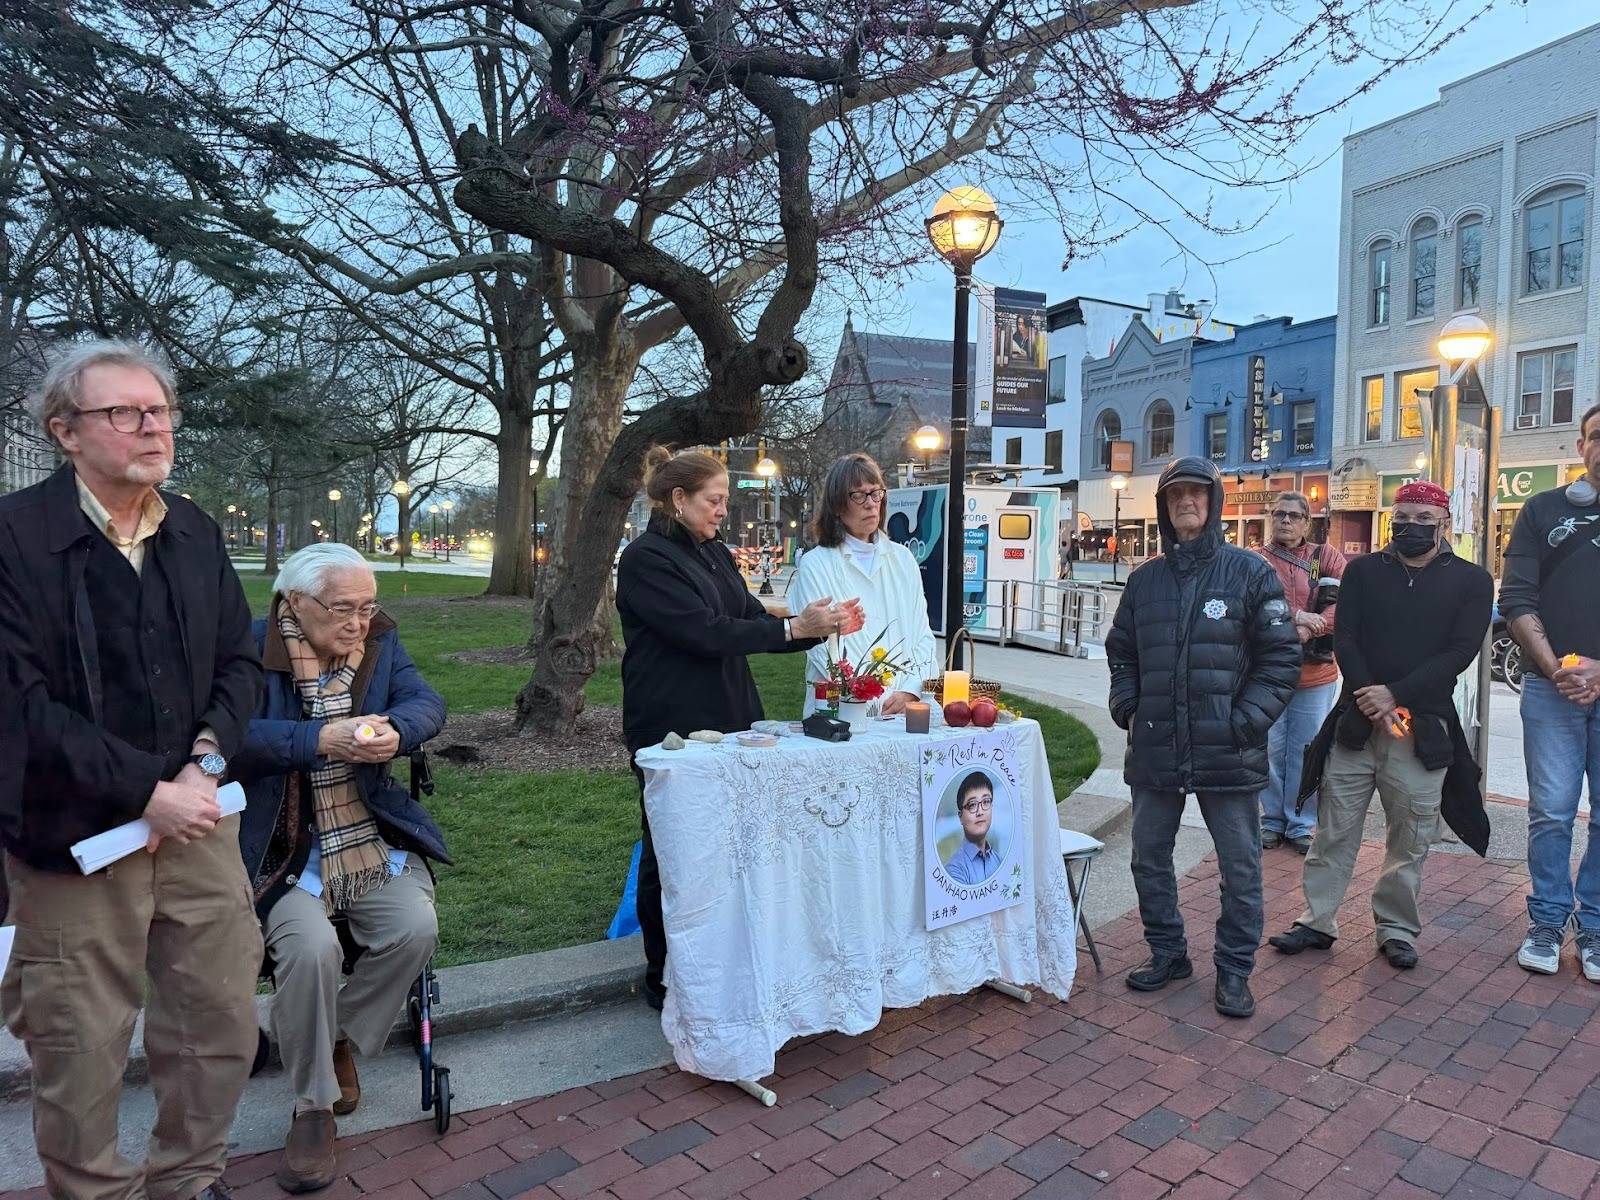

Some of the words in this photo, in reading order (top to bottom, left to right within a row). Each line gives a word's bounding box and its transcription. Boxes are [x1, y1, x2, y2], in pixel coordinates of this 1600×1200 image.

[1253, 357, 1265, 447] ASHLEY'S
[1296, 443, 1315, 451] YOGA
[1233, 492, 1272, 503] ASHLEY'S
[962, 514, 987, 522] rone
[948, 737, 976, 768] Rest
[978, 746, 988, 759] in
[990, 748, 1016, 787] Peace
[932, 866, 968, 901] DANHAO
[970, 879, 999, 901] WANG
